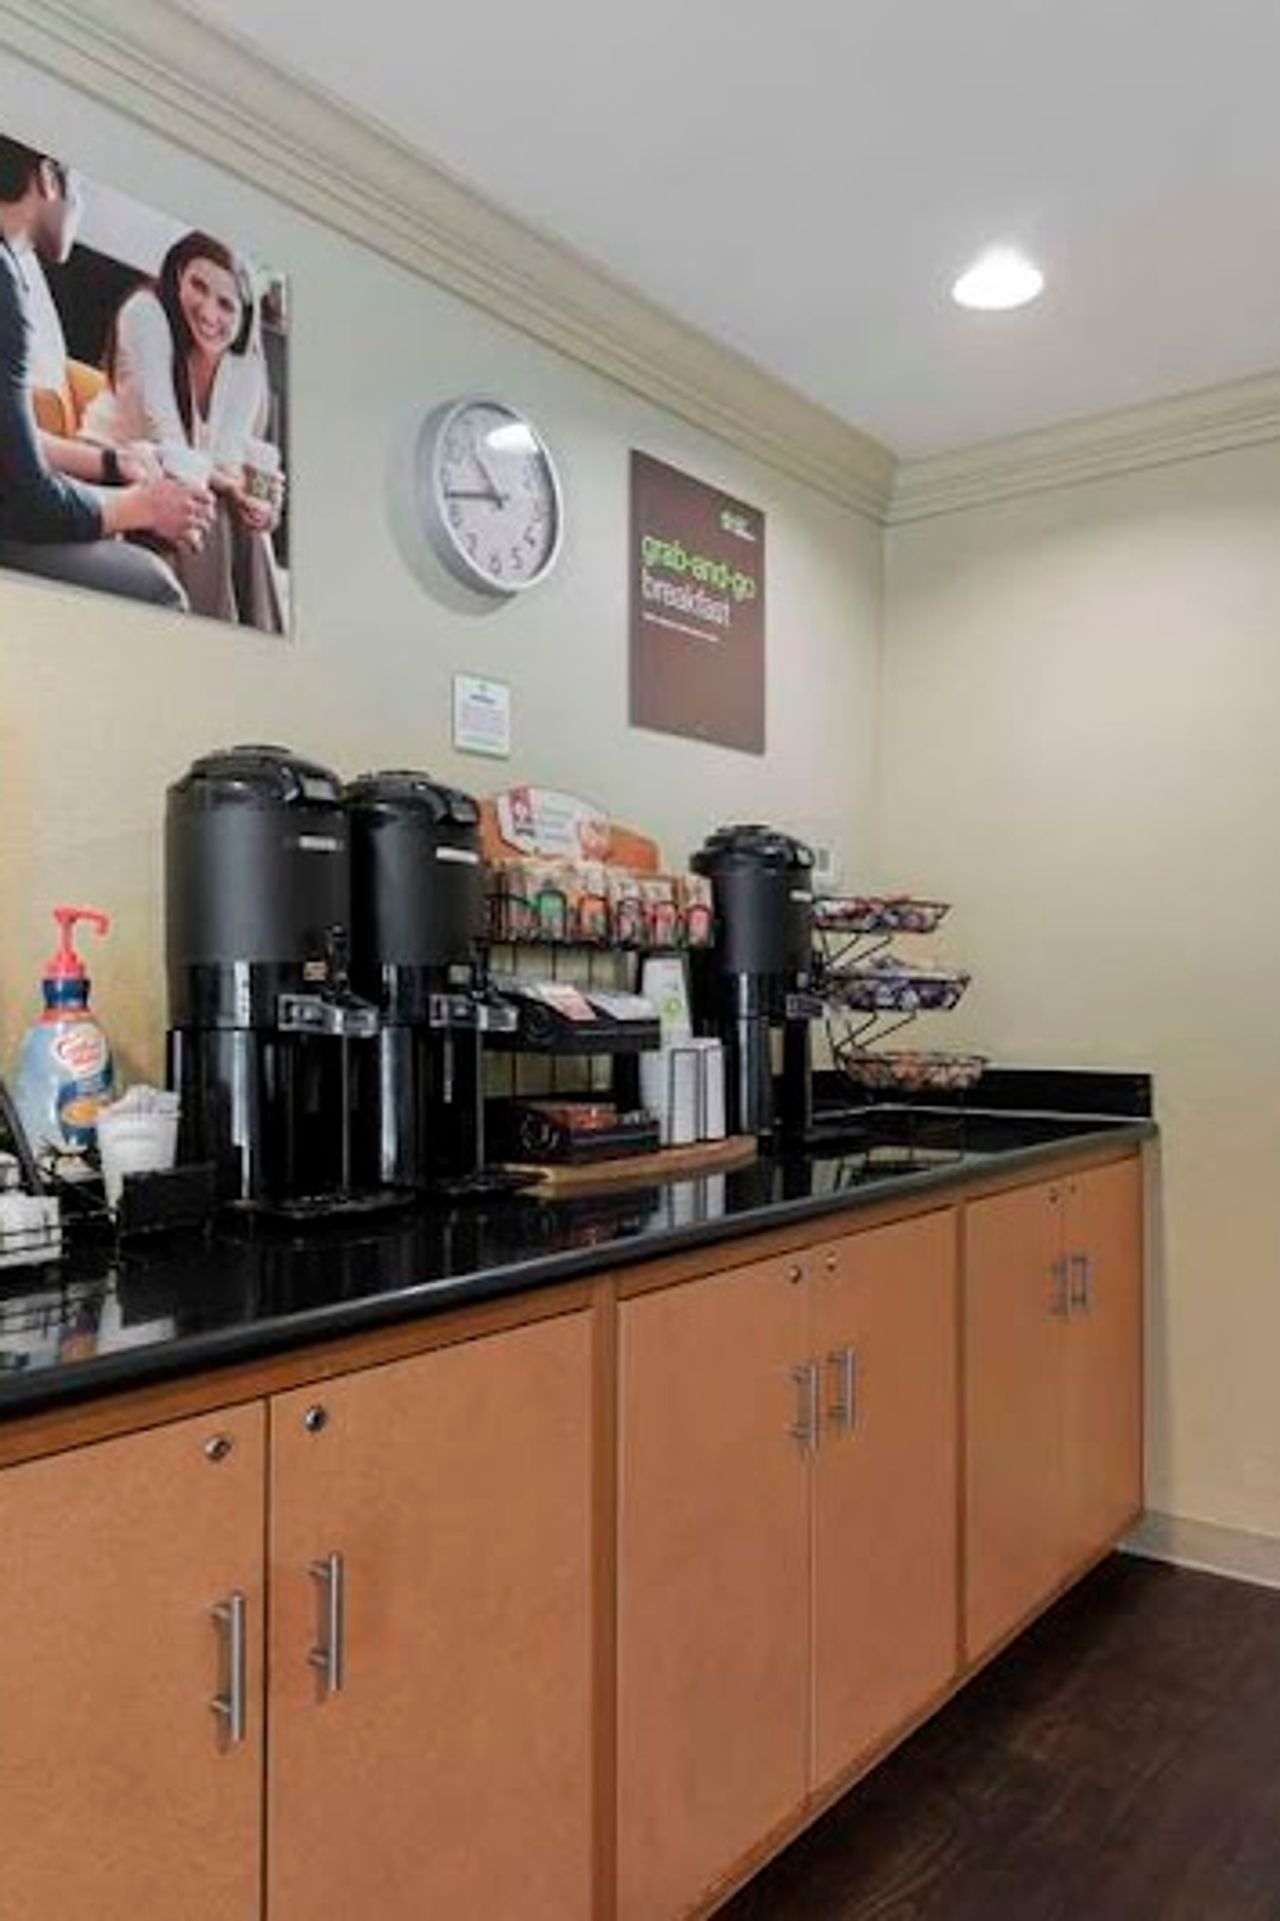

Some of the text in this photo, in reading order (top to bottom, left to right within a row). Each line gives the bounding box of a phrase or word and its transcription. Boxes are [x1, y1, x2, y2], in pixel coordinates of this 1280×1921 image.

[511, 546, 523, 570] 5
[641, 535, 755, 602] grab-and-go
[641, 566, 730, 628] breakfast
